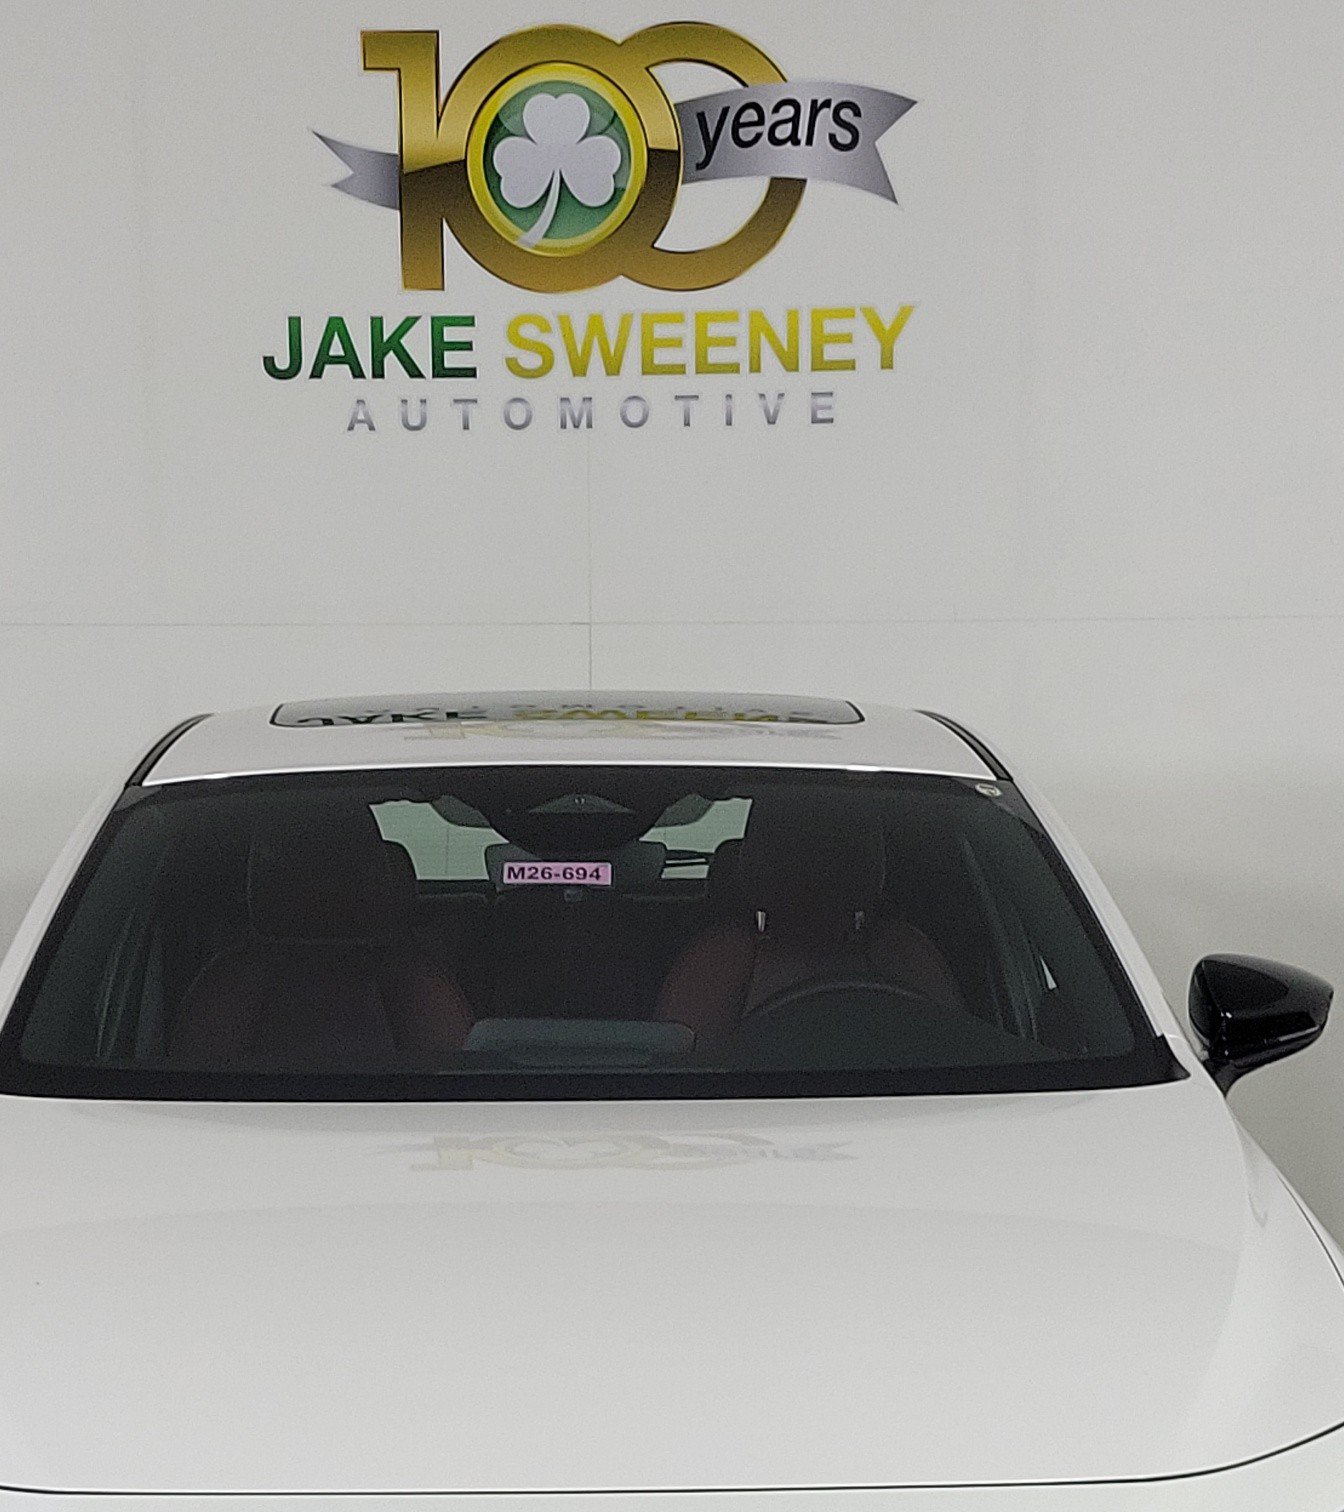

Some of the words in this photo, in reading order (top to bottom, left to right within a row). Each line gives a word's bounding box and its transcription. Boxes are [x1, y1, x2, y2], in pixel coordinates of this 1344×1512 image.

[361, 22, 808, 293] 100
[694, 95, 863, 170] years
[263, 315, 477, 381] JAKE
[504, 306, 915, 380] SWEENEY
[347, 391, 835, 432] AUTOMOTIVE
[507, 866, 602, 881] M26-694
